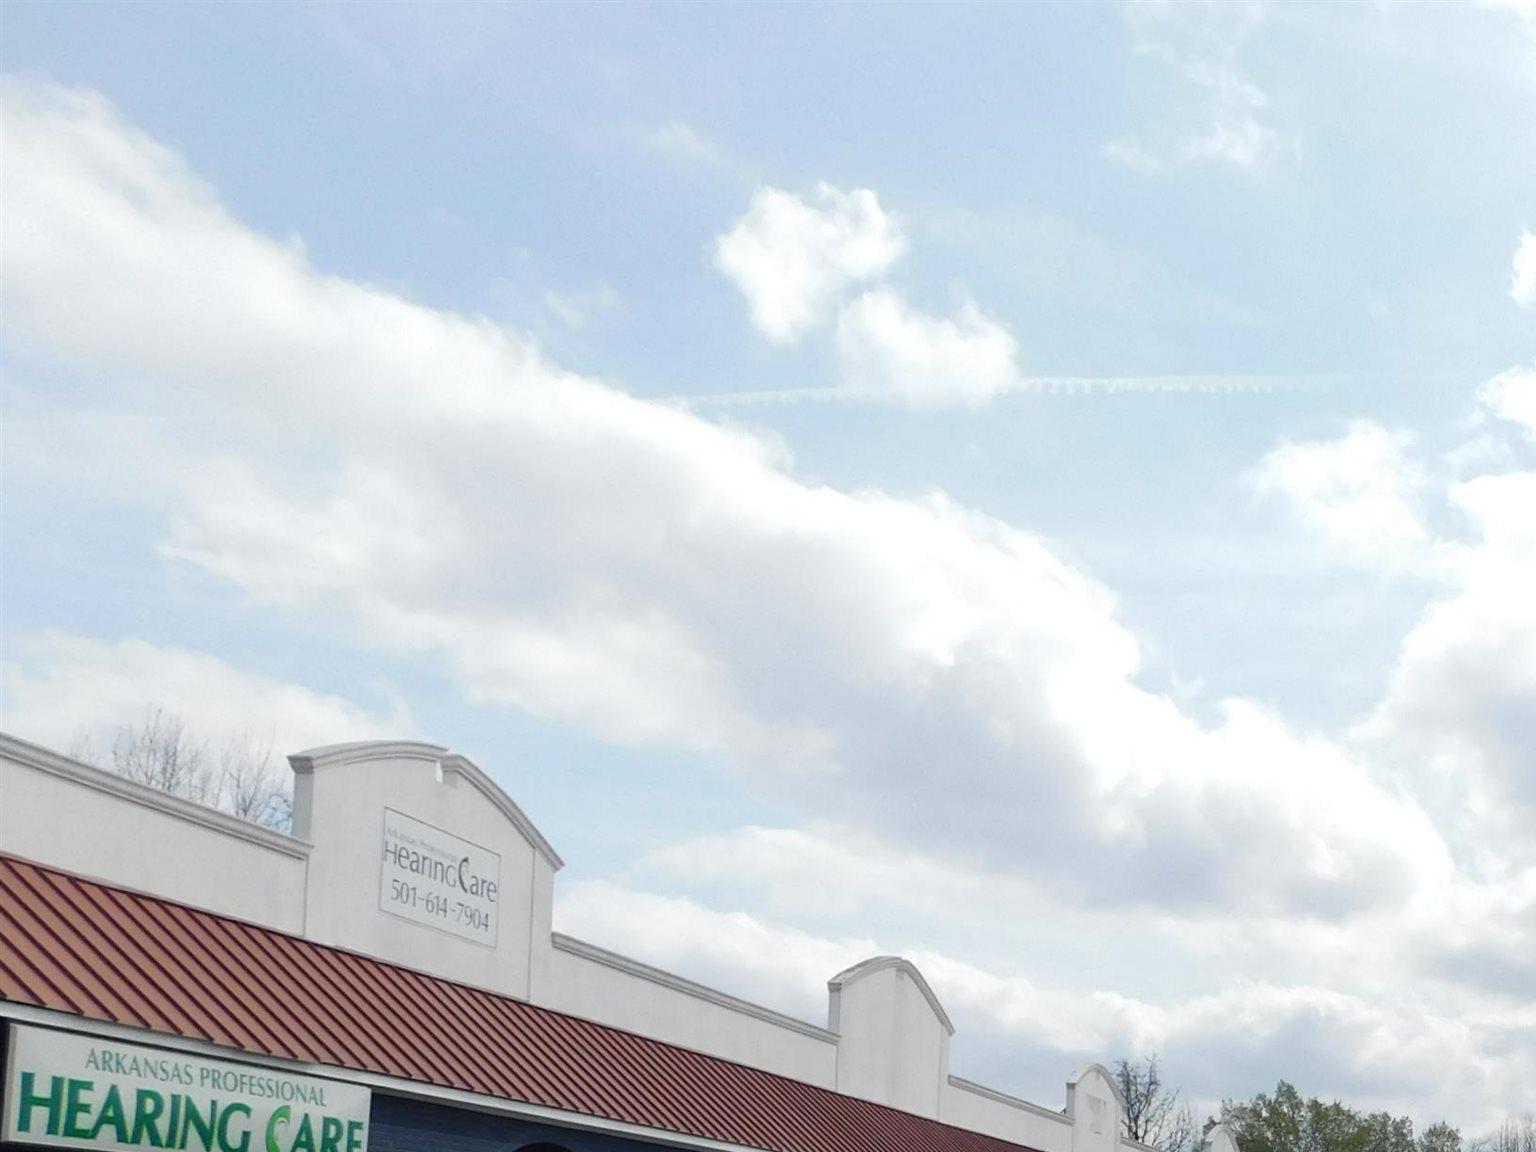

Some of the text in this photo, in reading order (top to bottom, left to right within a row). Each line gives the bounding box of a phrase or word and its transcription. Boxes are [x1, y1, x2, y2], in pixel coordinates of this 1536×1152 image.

[390, 879, 489, 932] 501-614-7904
[457, 856, 498, 903] Care
[85, 1048, 328, 1107] ARKANSAS PROFESSIONAL
